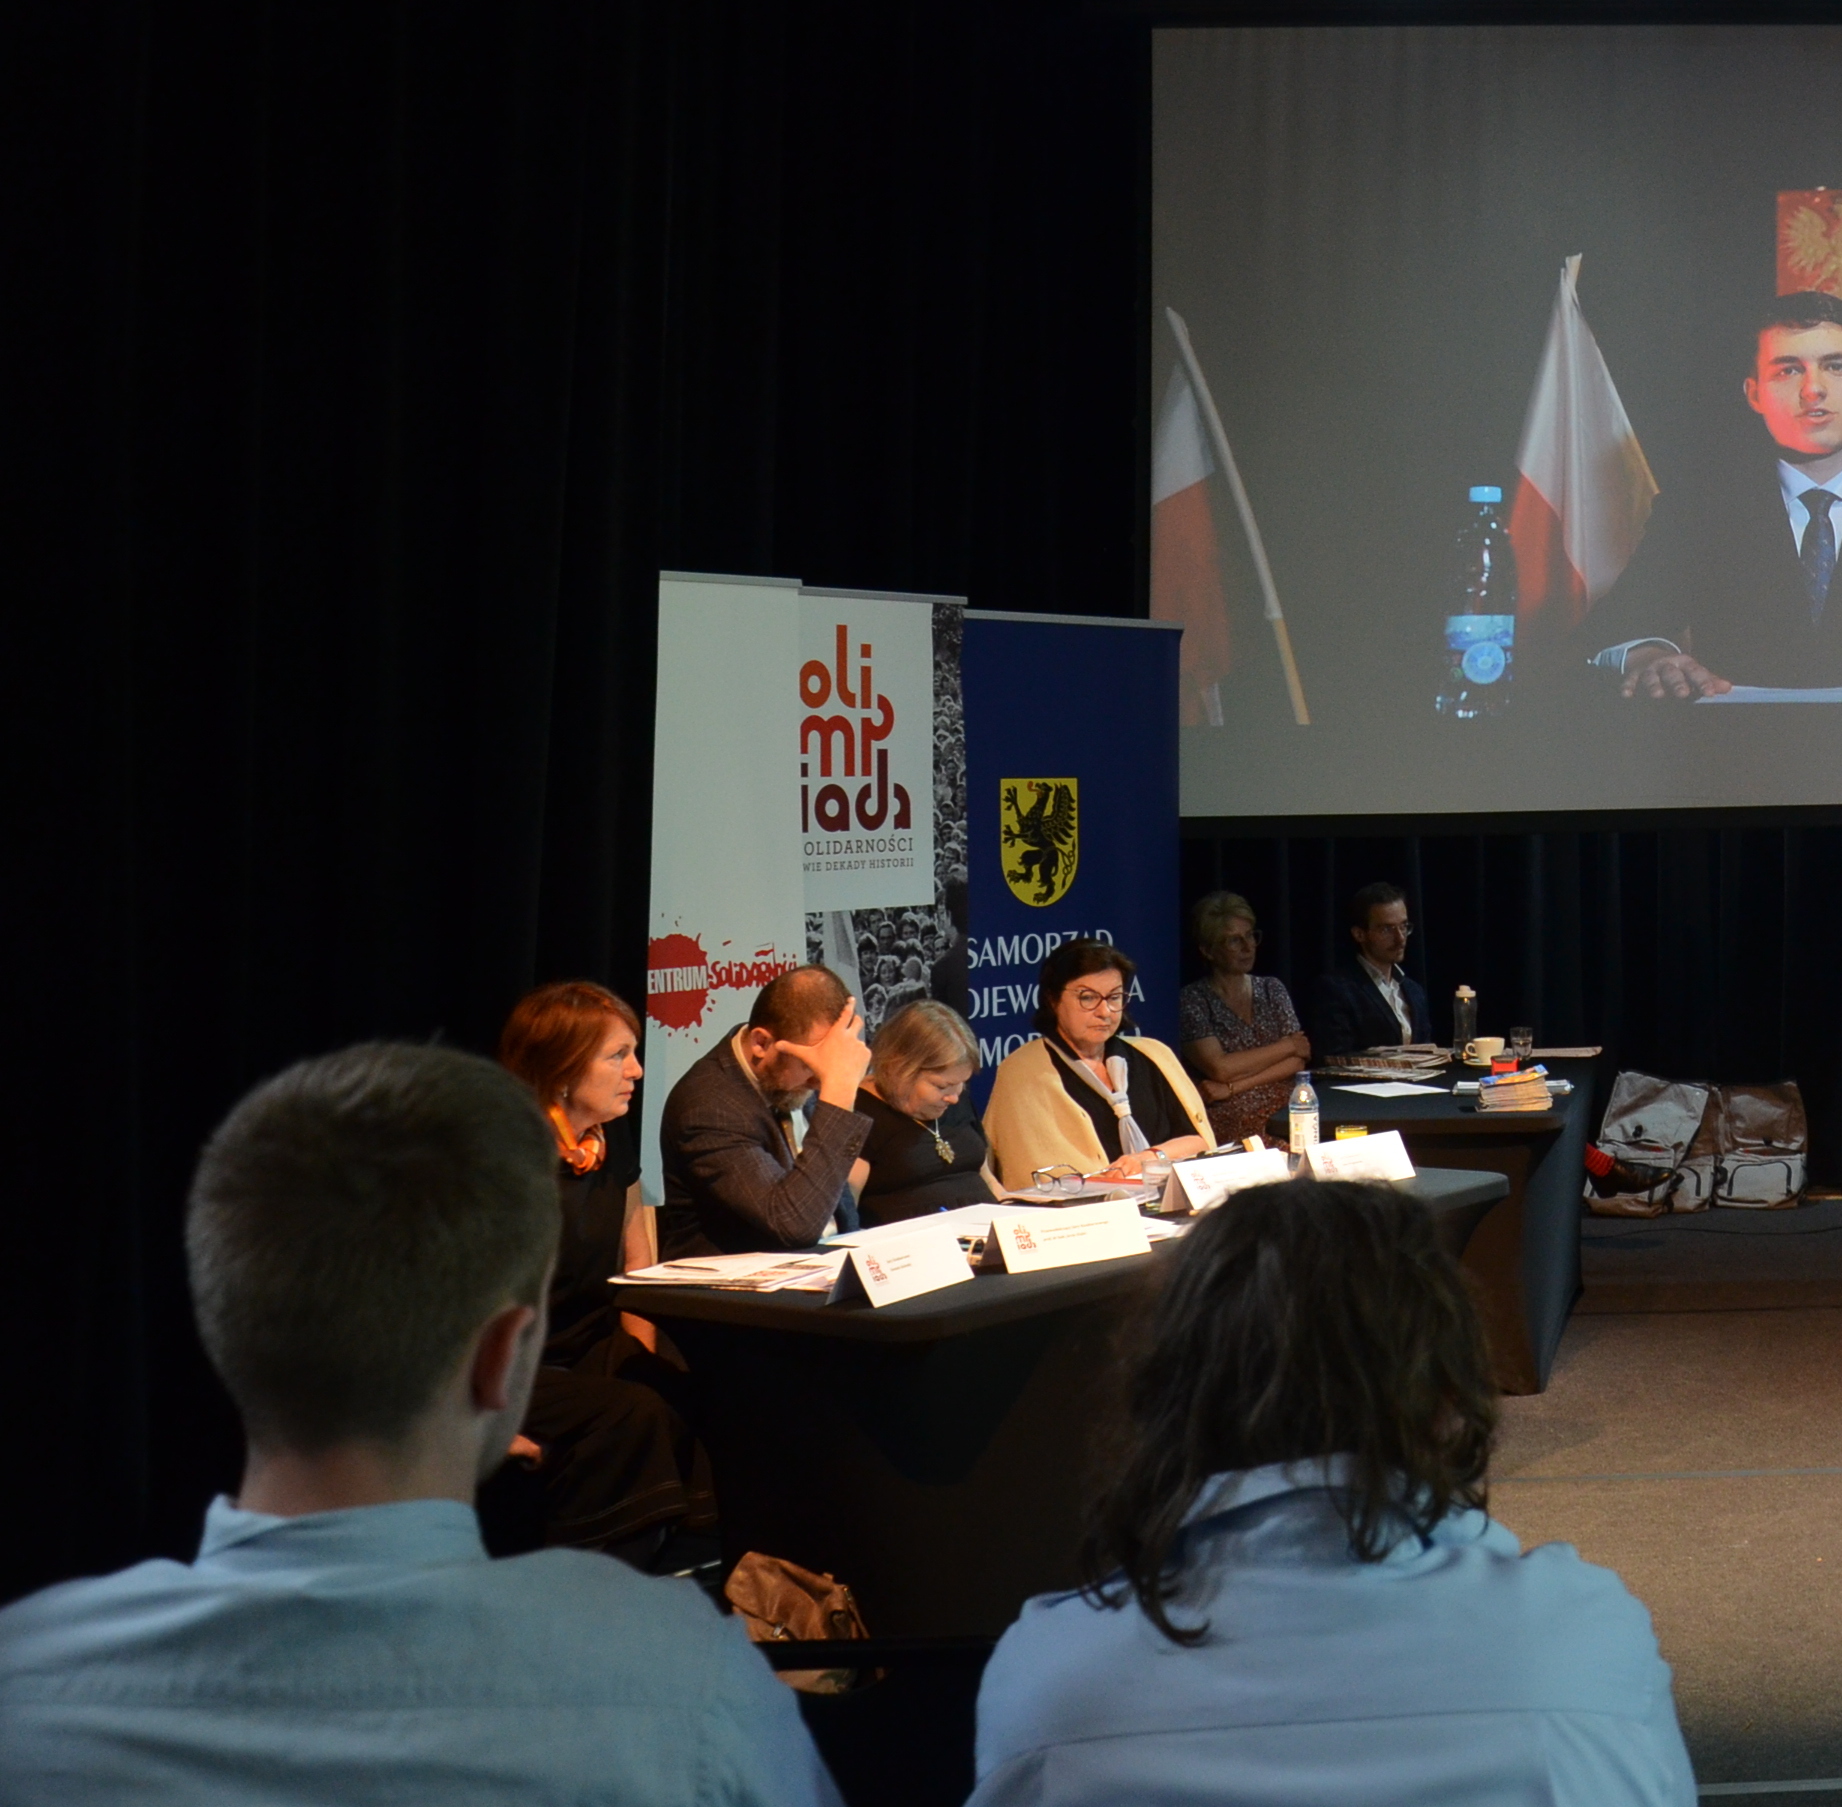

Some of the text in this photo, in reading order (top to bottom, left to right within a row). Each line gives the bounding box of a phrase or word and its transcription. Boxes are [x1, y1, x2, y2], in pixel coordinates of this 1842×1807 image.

[803, 834, 914, 856] OLIDARNOŚCI
[802, 857, 914, 873] WIE DEKADY HISTORII
[647, 965, 708, 995] ENTRUM
